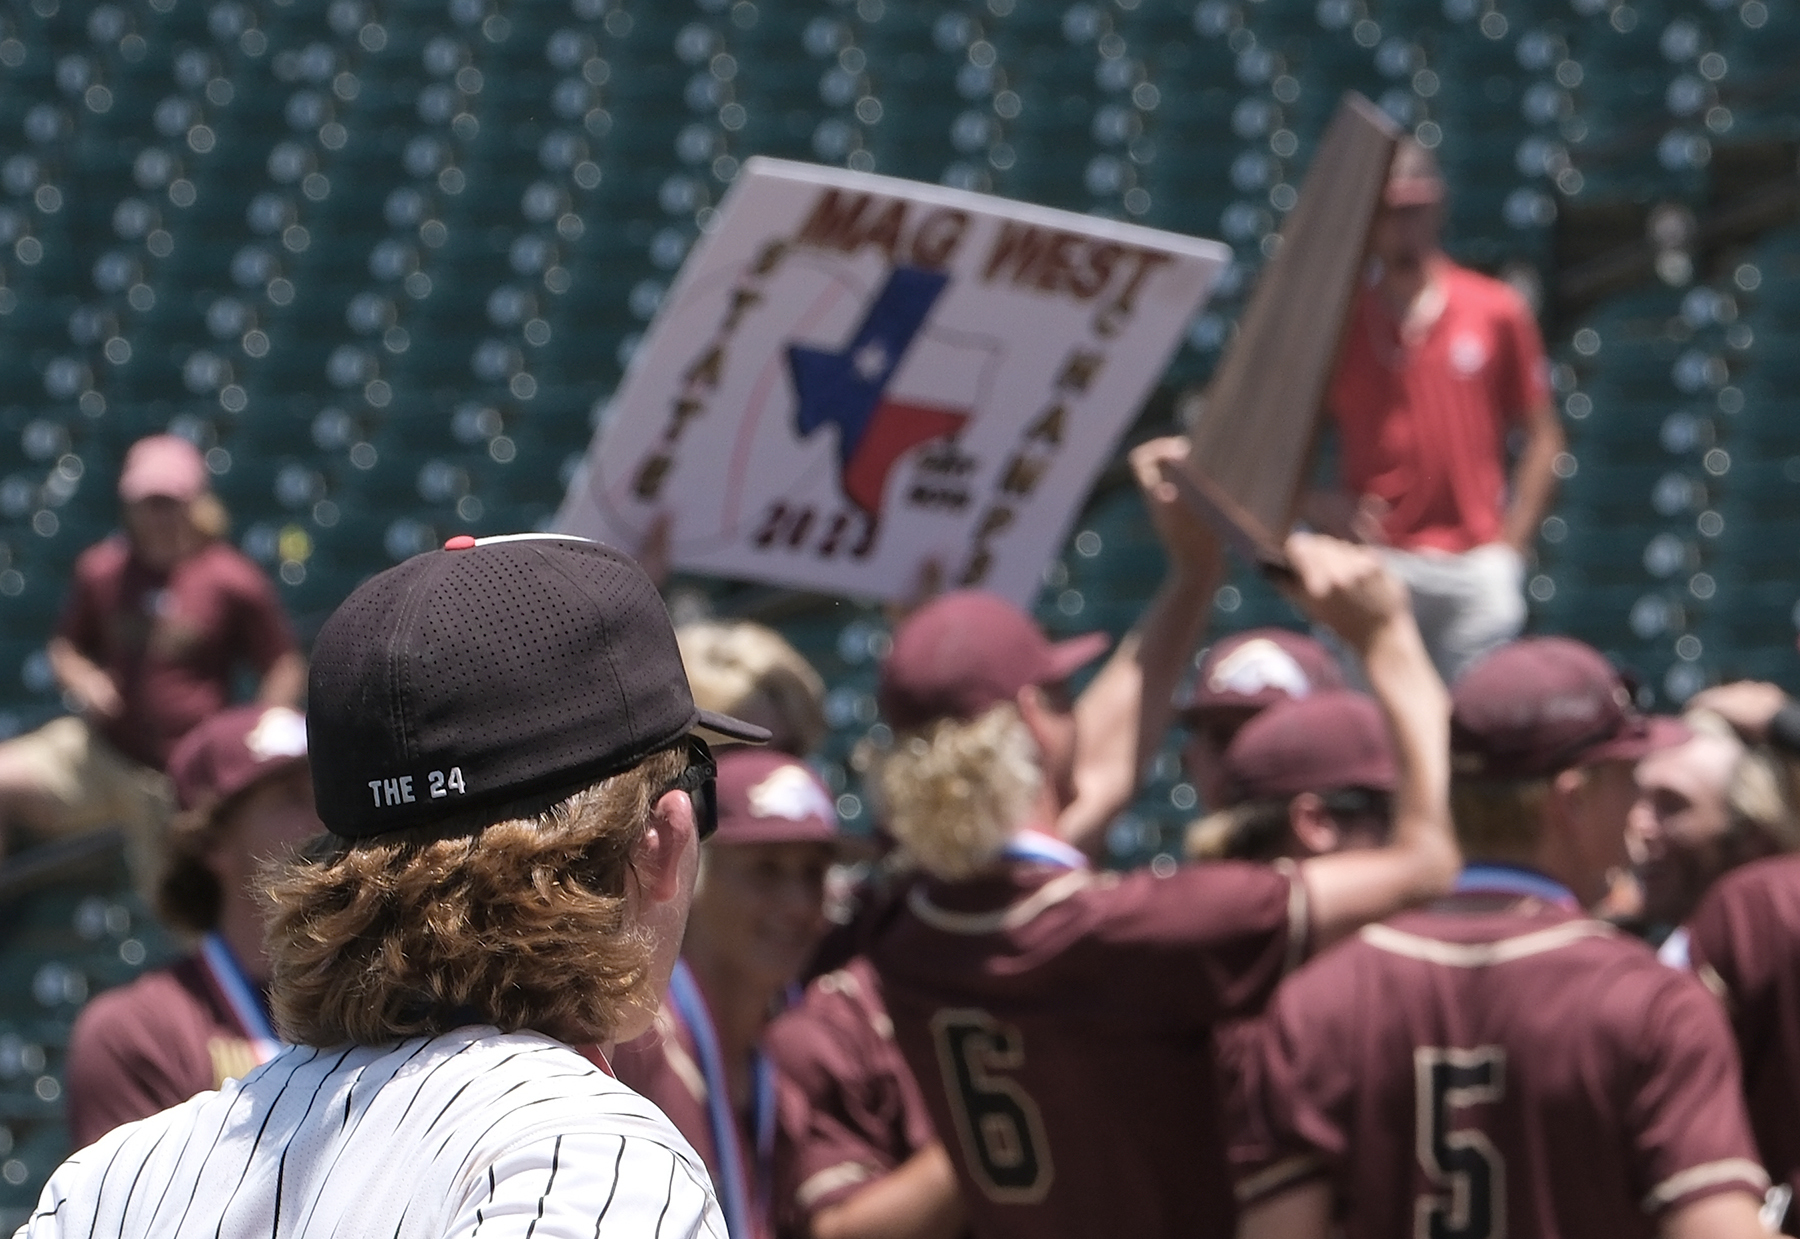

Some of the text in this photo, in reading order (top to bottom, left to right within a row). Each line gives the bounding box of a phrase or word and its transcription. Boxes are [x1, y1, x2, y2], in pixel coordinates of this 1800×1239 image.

[800, 188, 1172, 312] MAG WEST
[368, 766, 466, 808] THE 24
[931, 1008, 1056, 1204] 6
